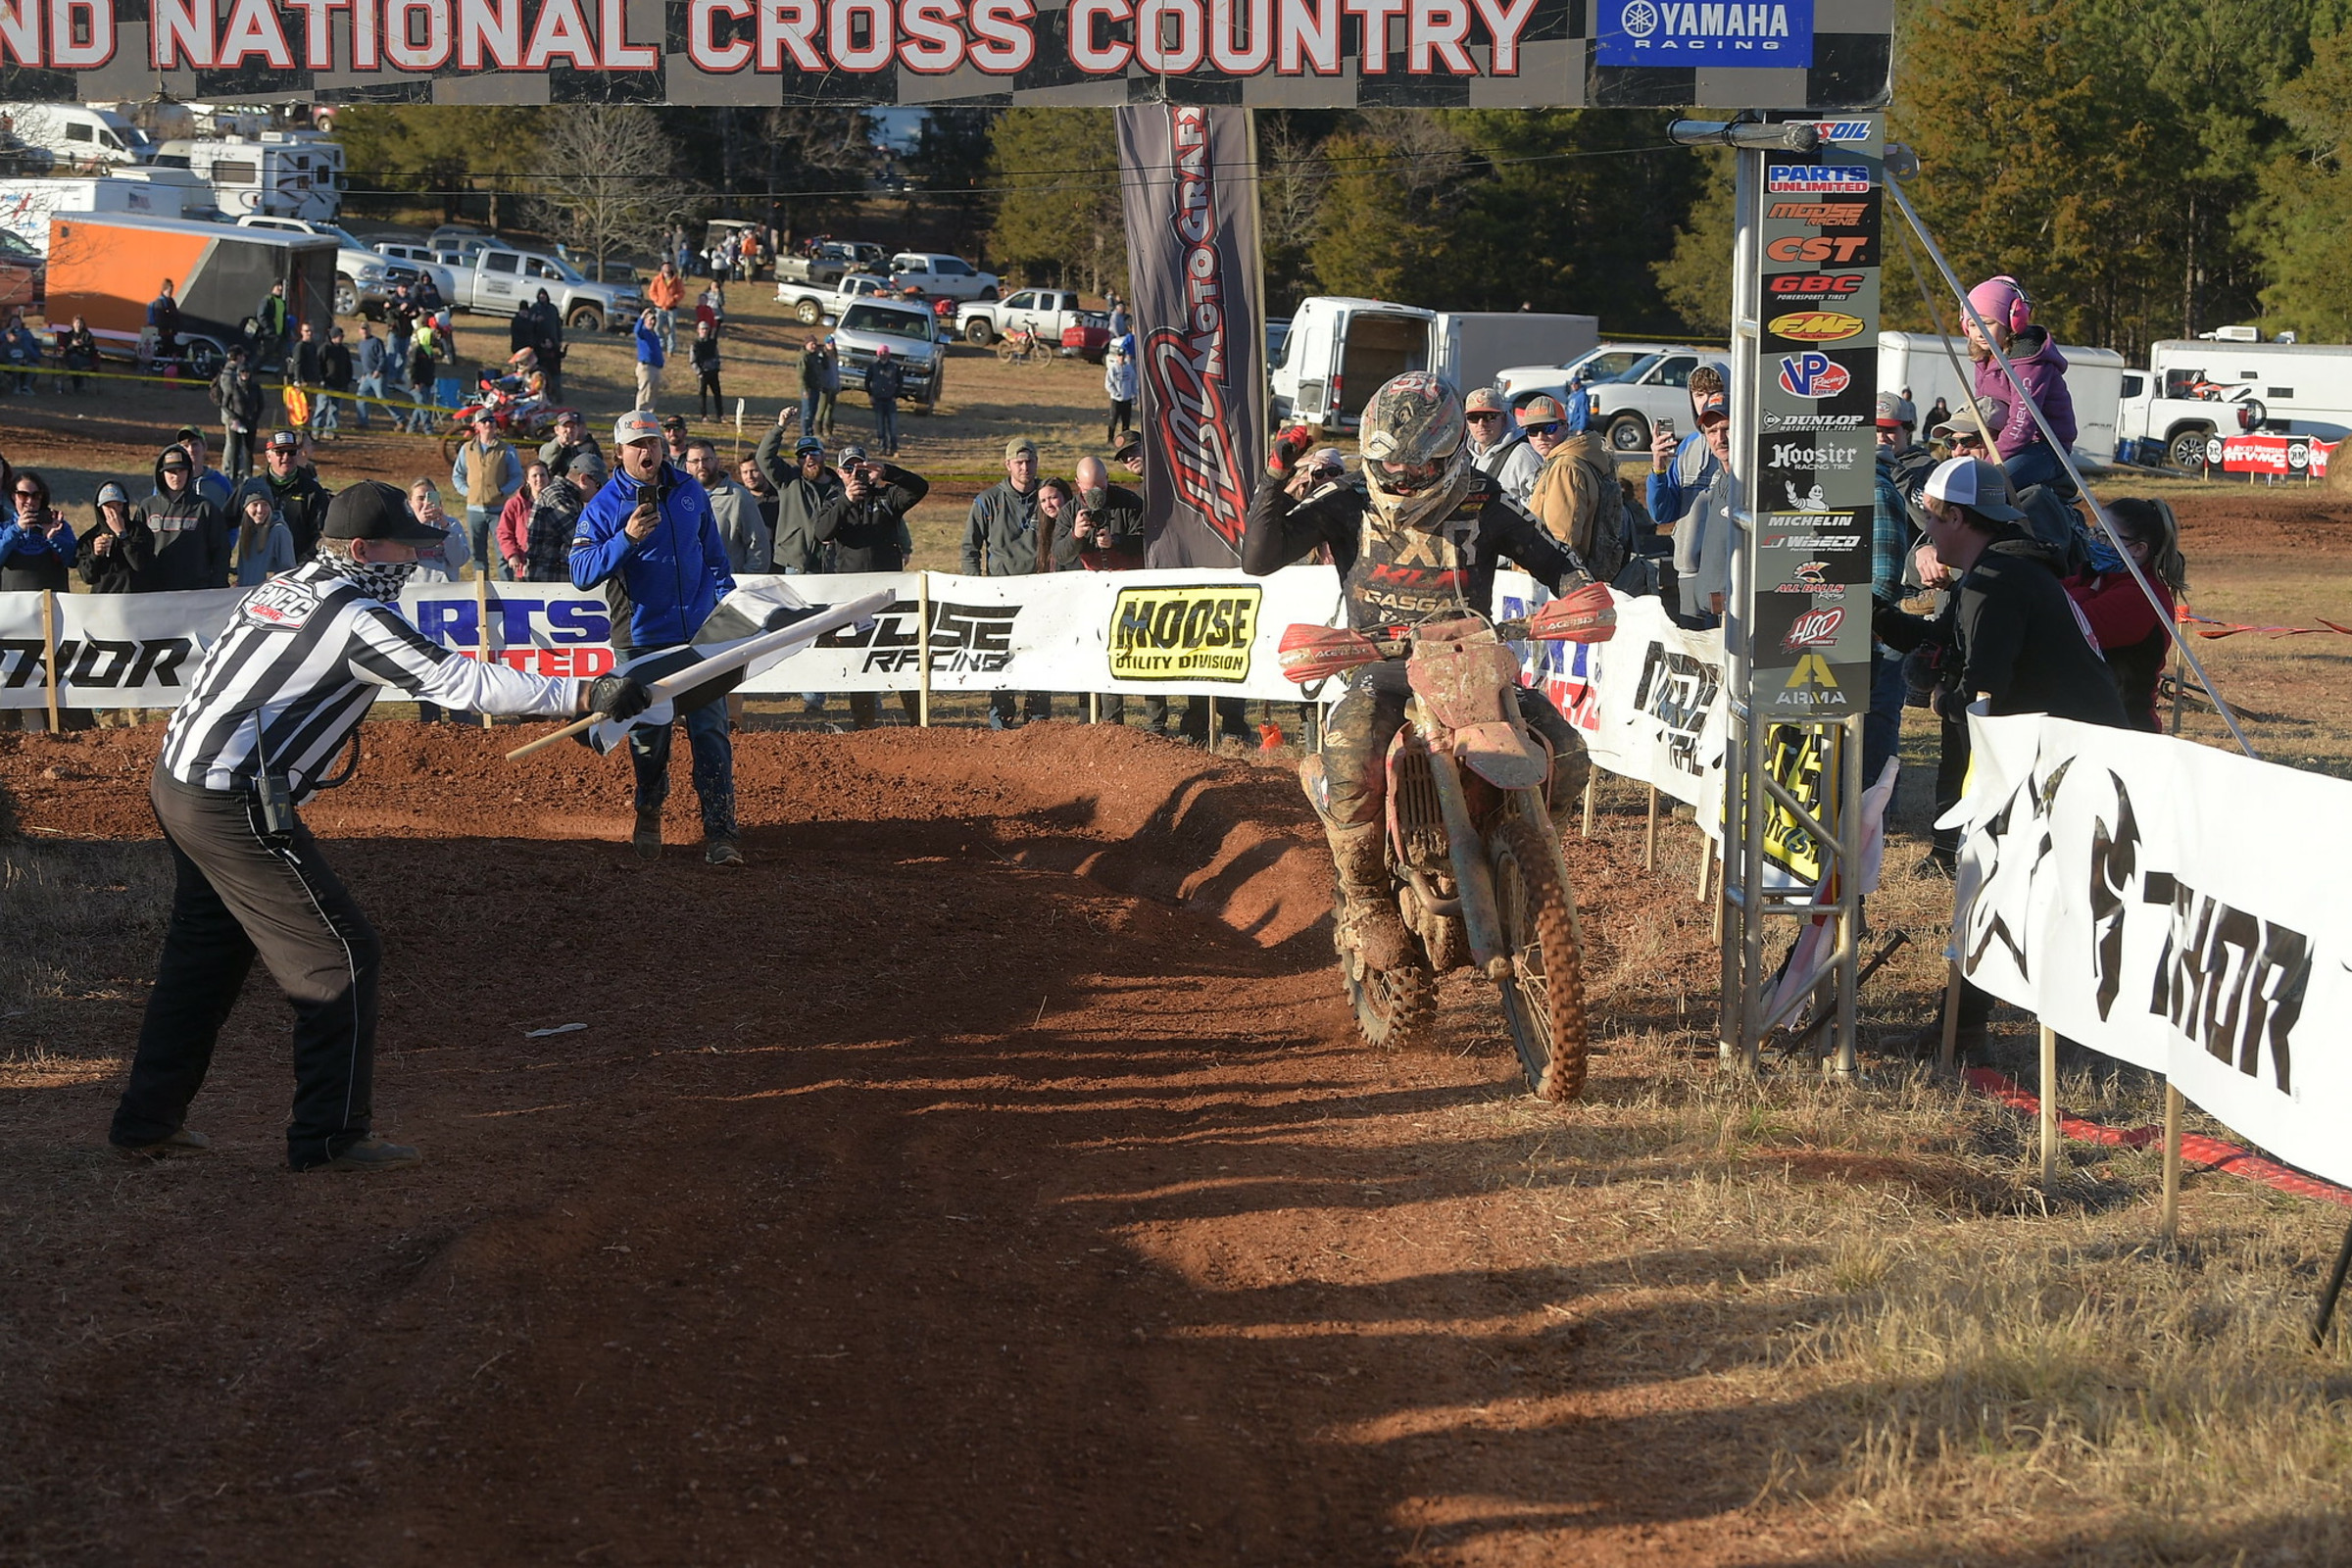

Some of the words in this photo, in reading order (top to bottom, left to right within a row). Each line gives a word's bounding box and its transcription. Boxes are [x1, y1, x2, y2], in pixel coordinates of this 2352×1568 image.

[1664, 3, 1789, 37] YAMAHA
[146, 0, 660, 71] NATIONAL
[688, 0, 1036, 74] CROSS
[1069, 0, 1537, 75] COUNTRY
[1635, 40, 1780, 50] RACING
[1789, 122, 1870, 140] SOIL
[1769, 165, 1870, 181] PARTS
[1769, 182, 1869, 192] UNLIMITED
[1767, 203, 1868, 219] MOOSE
[1805, 218, 1860, 226] RACING
[1766, 237, 1868, 263] CST
[1770, 275, 1864, 292] GBC
[1770, 316, 1863, 333] FMF
[1779, 352, 1830, 397] VP
[1812, 374, 1851, 390] Racing
[1782, 416, 1865, 425] DUNLOP
[1767, 442, 1858, 468] Hoosier
[1768, 516, 1854, 526] MICHELIN
[1361, 509, 1481, 570] FXR
[1775, 584, 1801, 593] ALL
[1802, 583, 1845, 593] BALLS
[249, 583, 315, 618] GNCC
[1364, 589, 1470, 612] GASGAS
[250, 605, 284, 621] RACING
[386, 600, 612, 647] RTS
[1115, 599, 1252, 650] MOOSE
[1115, 655, 1173, 670] UTILITY
[1178, 654, 1244, 670] DIVISION
[1775, 691, 1847, 704] ARMA
[2142, 869, 2314, 1098] THOR
